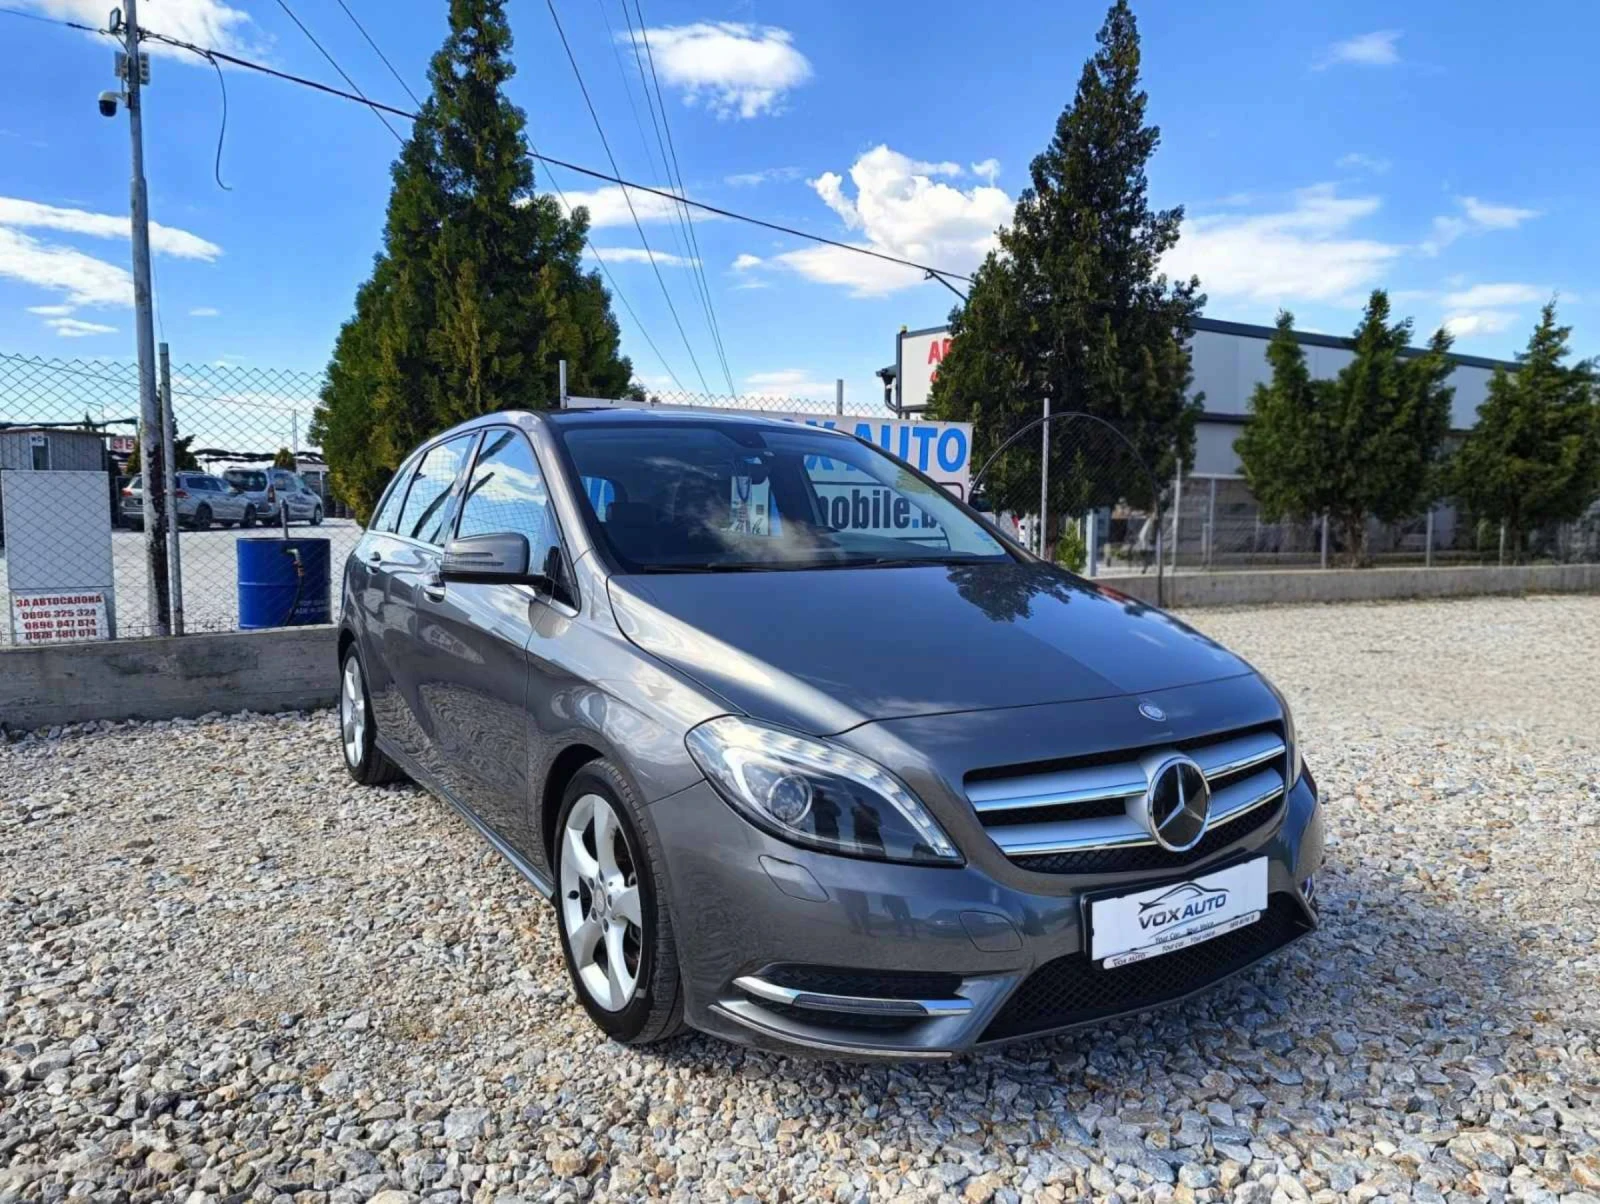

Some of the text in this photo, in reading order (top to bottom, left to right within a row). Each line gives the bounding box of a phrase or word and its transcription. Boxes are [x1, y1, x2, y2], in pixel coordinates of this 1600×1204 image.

[16, 596, 102, 607] ЗА АВТОСАЛОНА
[54, 609, 75, 617] 325
[76, 608, 96, 617] 324
